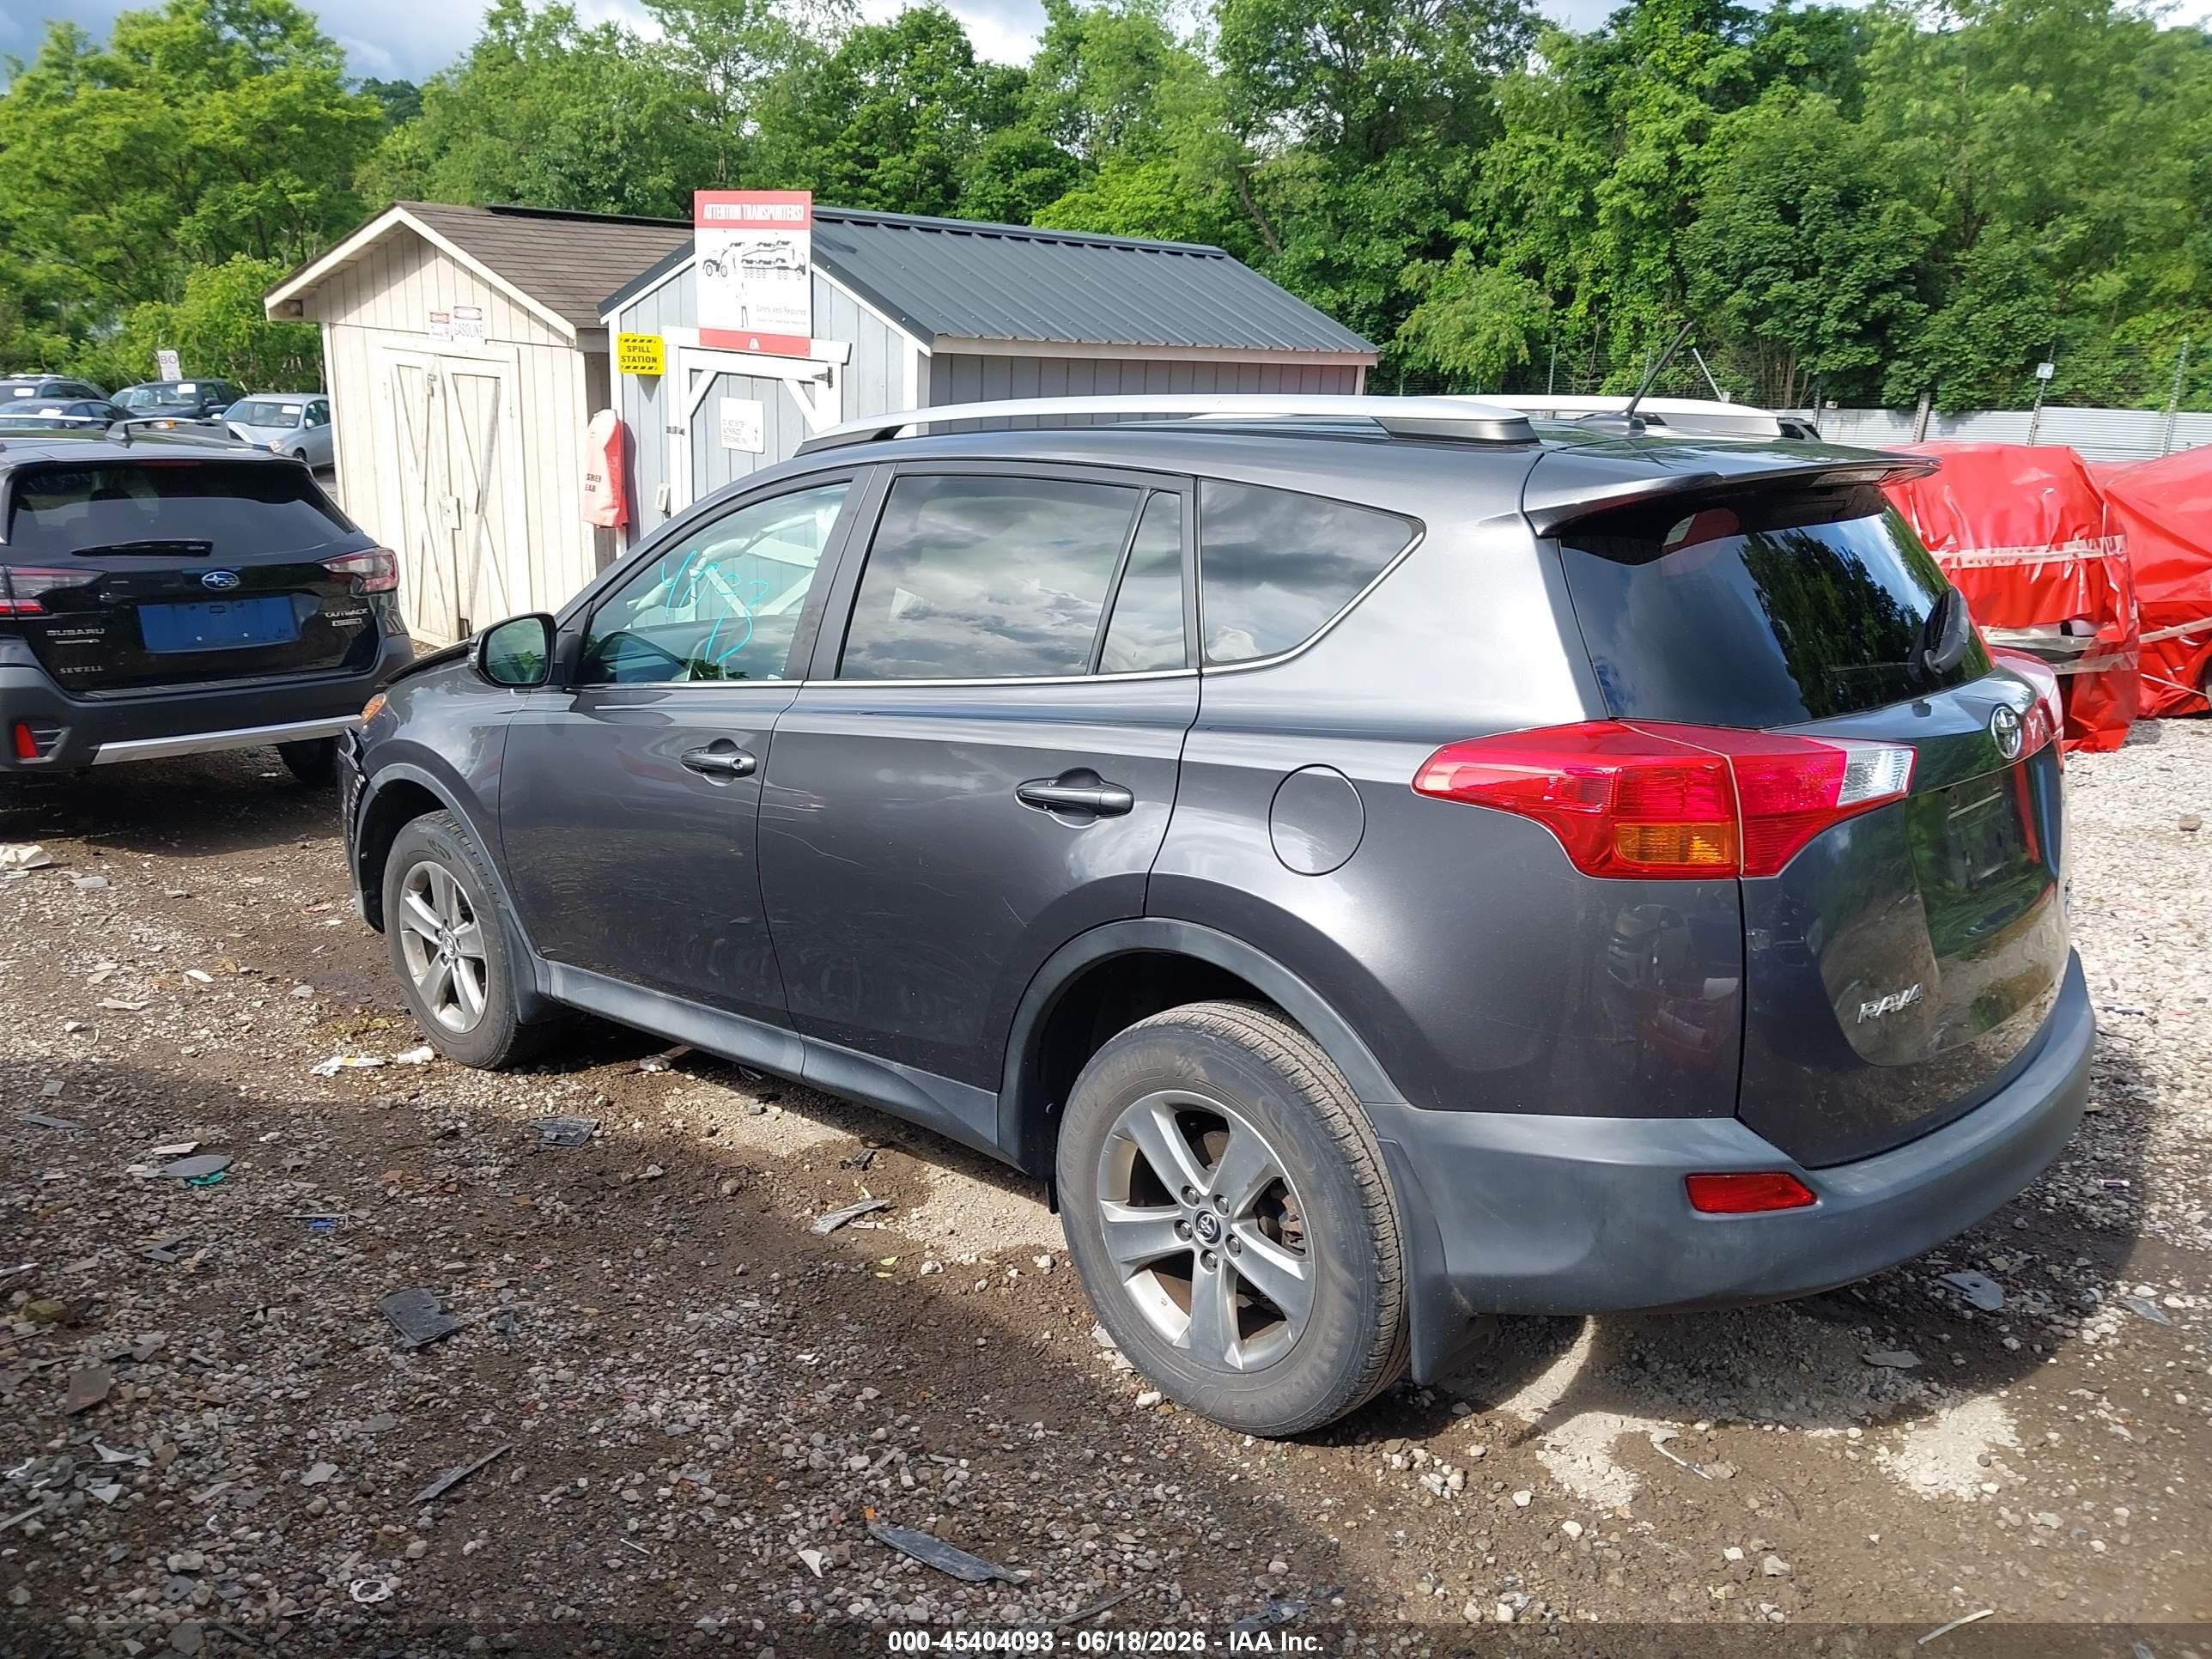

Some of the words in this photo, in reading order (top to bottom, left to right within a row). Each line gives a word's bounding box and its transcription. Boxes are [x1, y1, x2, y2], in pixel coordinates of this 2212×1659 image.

[703, 204, 742, 221] ATTENTION
[620, 356, 658, 364] STATION
[325, 608, 368, 618] OUTBACK
[59, 665, 104, 674] SEWELL
[1856, 982, 1924, 1024] RAV4
